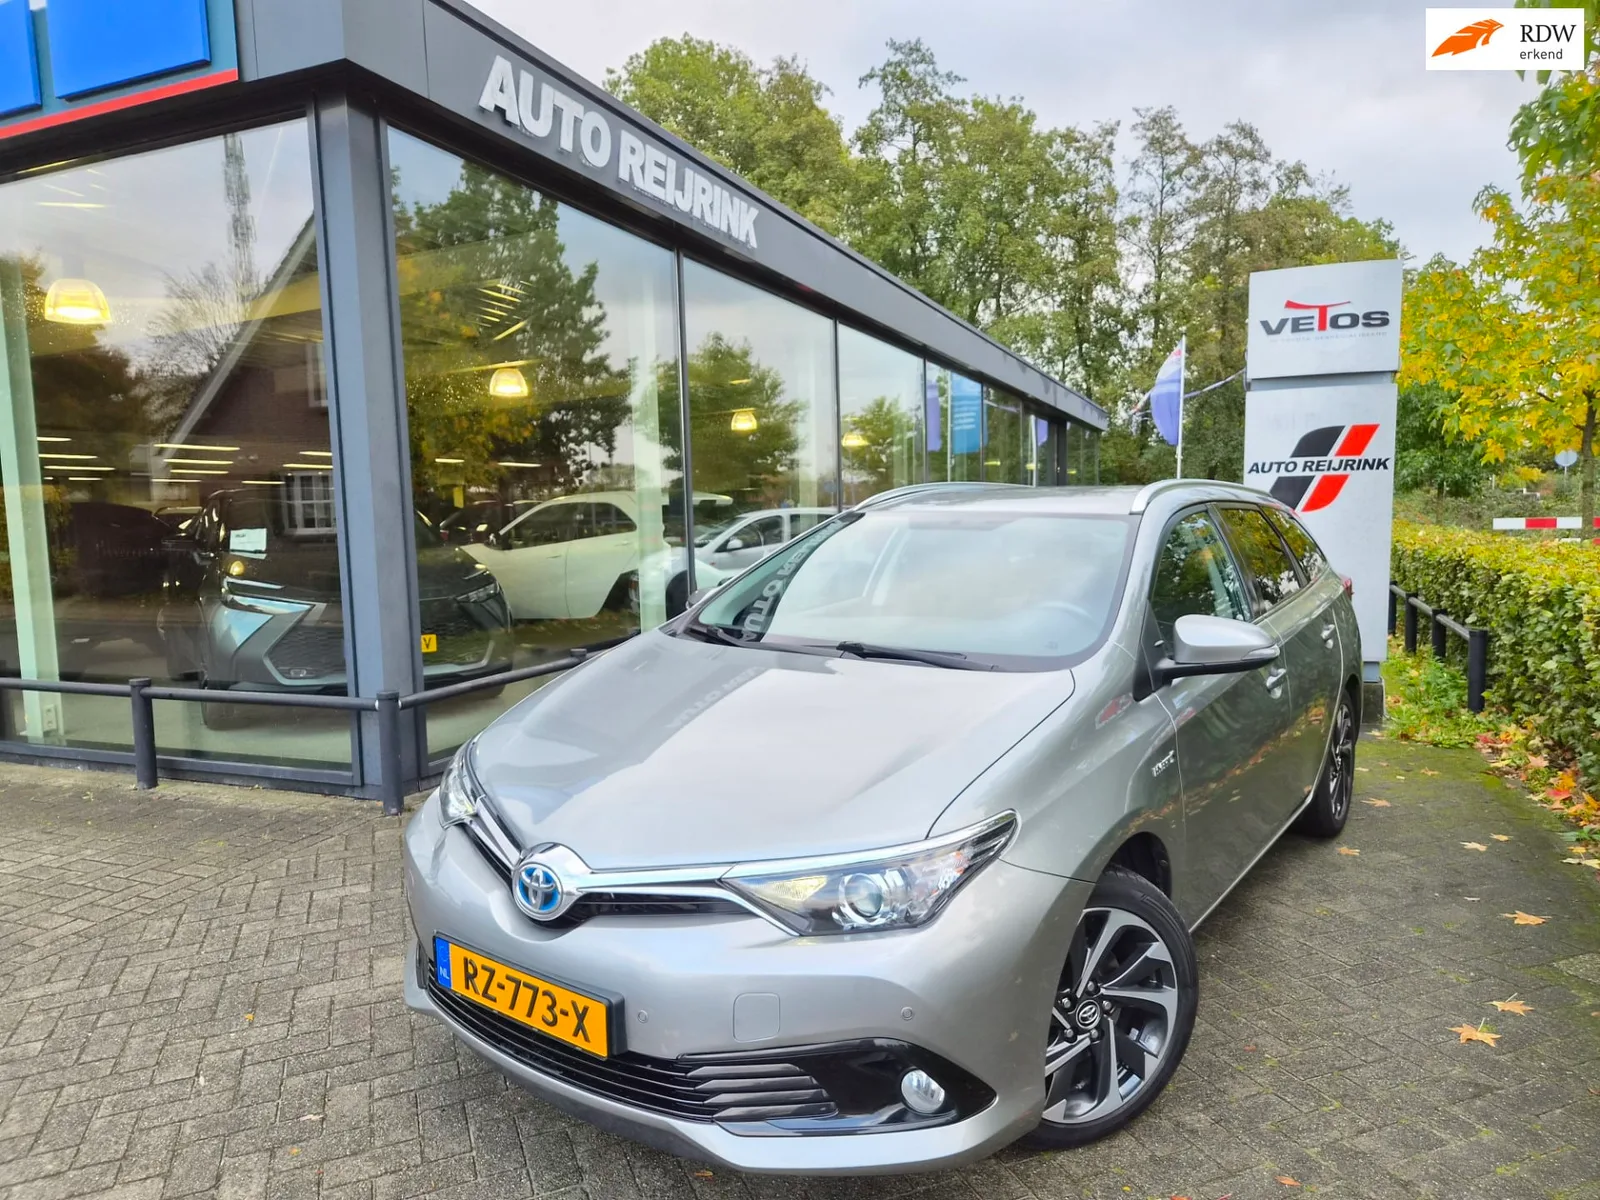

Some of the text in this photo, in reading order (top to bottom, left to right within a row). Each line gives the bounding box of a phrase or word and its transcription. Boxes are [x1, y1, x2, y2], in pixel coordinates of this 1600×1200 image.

[478, 54, 759, 249] AUTO REIJRINK
[1259, 299, 1390, 336] VETOS
[1248, 457, 1391, 474] AUTO REIJRINK
[439, 965, 450, 980] NL
[463, 956, 591, 1044] RZ-773-X
